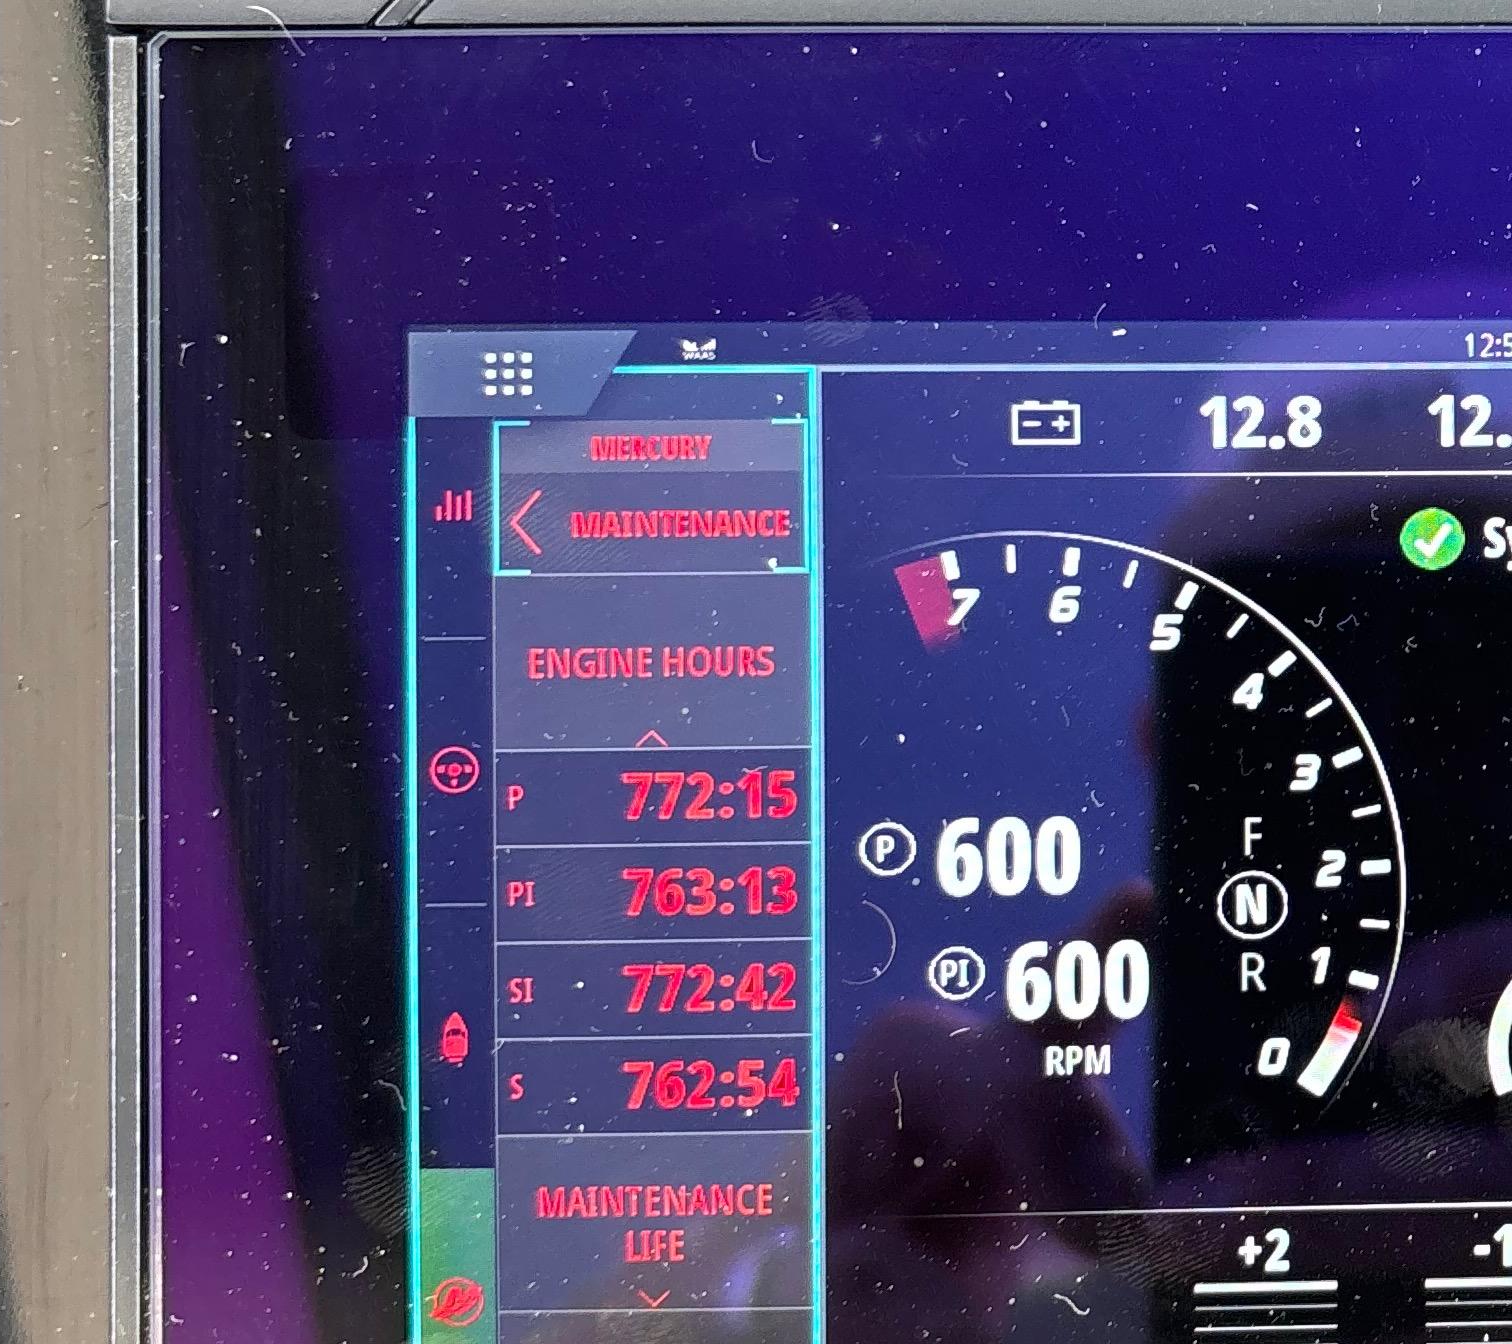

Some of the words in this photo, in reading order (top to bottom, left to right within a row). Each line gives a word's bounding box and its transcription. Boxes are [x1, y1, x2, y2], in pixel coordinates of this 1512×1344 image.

[1200, 395, 1323, 449] 12.8
[590, 435, 712, 461] MERCURY
[570, 509, 790, 539] MAINTENANCE
[947, 588, 981, 626] 7
[1048, 588, 1082, 624] 6
[1148, 614, 1183, 651] 5
[528, 647, 653, 680] ENGINE
[663, 646, 775, 678] HOURS
[1232, 670, 1264, 710] 4
[1290, 754, 1323, 791] 3
[508, 786, 524, 811] P
[622, 770, 799, 821] 772:15
[1244, 817, 1263, 856] F
[876, 835, 895, 862] P
[936, 815, 1082, 898] 600
[1315, 849, 1346, 888] 2
[508, 881, 535, 907] PI
[622, 866, 799, 917] 763:13
[1235, 883, 1268, 927] N
[940, 960, 970, 989] PI
[1005, 939, 1150, 1022] 600
[1241, 953, 1268, 992] R
[1311, 947, 1332, 984] 1
[509, 977, 533, 1004] SI
[622, 963, 798, 1012] 772:42
[1045, 1045, 1112, 1077] RPM
[1258, 1037, 1290, 1076] 0
[509, 1074, 524, 1100] S
[622, 1059, 799, 1109] 762:54
[537, 1183, 773, 1220] MAINTENANCE
[624, 1229, 684, 1263] LIFE
[1238, 1229, 1291, 1274] +2
